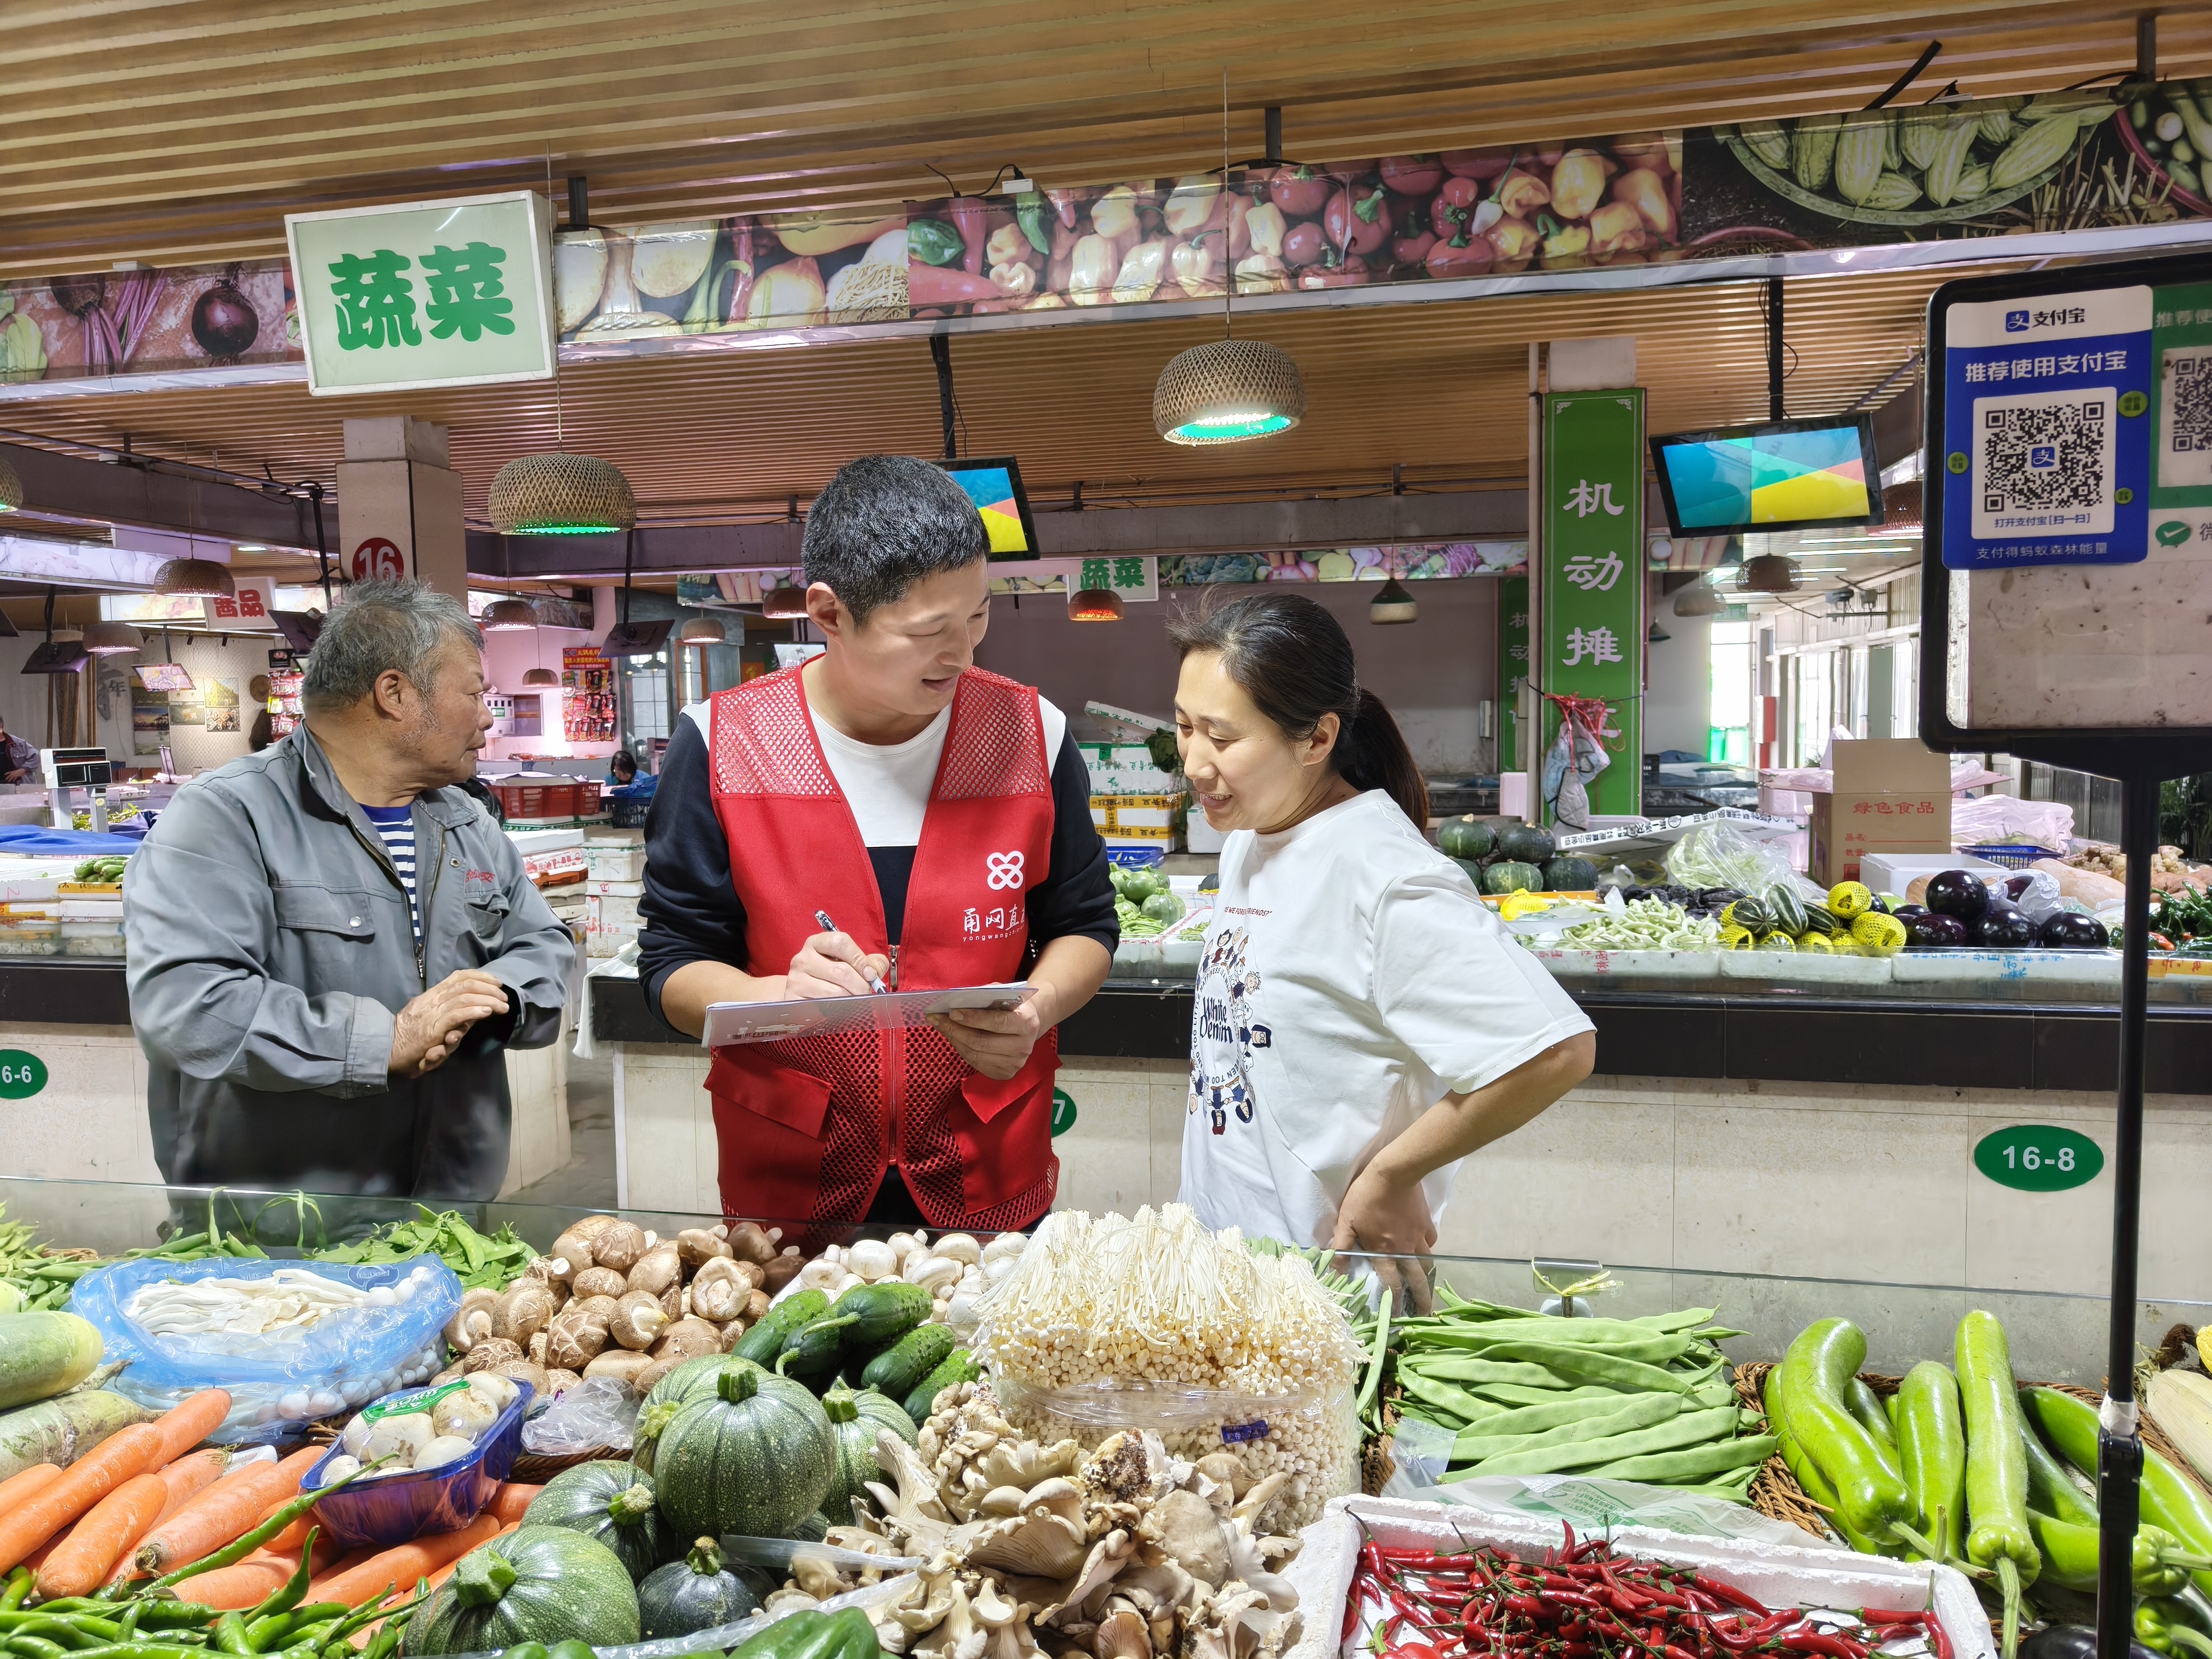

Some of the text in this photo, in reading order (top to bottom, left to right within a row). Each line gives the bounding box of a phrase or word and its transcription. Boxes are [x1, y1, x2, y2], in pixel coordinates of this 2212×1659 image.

[328, 241, 516, 351] 蔬菜
[2032, 307, 2086, 327] 支付宝
[1965, 350, 2128, 383] 推荐使用支付宝
[1976, 542, 2107, 559] 支付得蚂蚁森林能量
[359, 546, 397, 583] 16
[1081, 558, 1145, 590] 蔬菜
[1562, 480, 1625, 738] 机动摊
[1853, 801, 1934, 814] 绿色食品
[1202, 996, 1228, 1023] White
[1200, 1015, 1233, 1044] Denim
[1, 1065, 32, 1083] 6-6
[1211, 1075, 1225, 1084] TOO
[2002, 1145, 2075, 1171] 16-8
